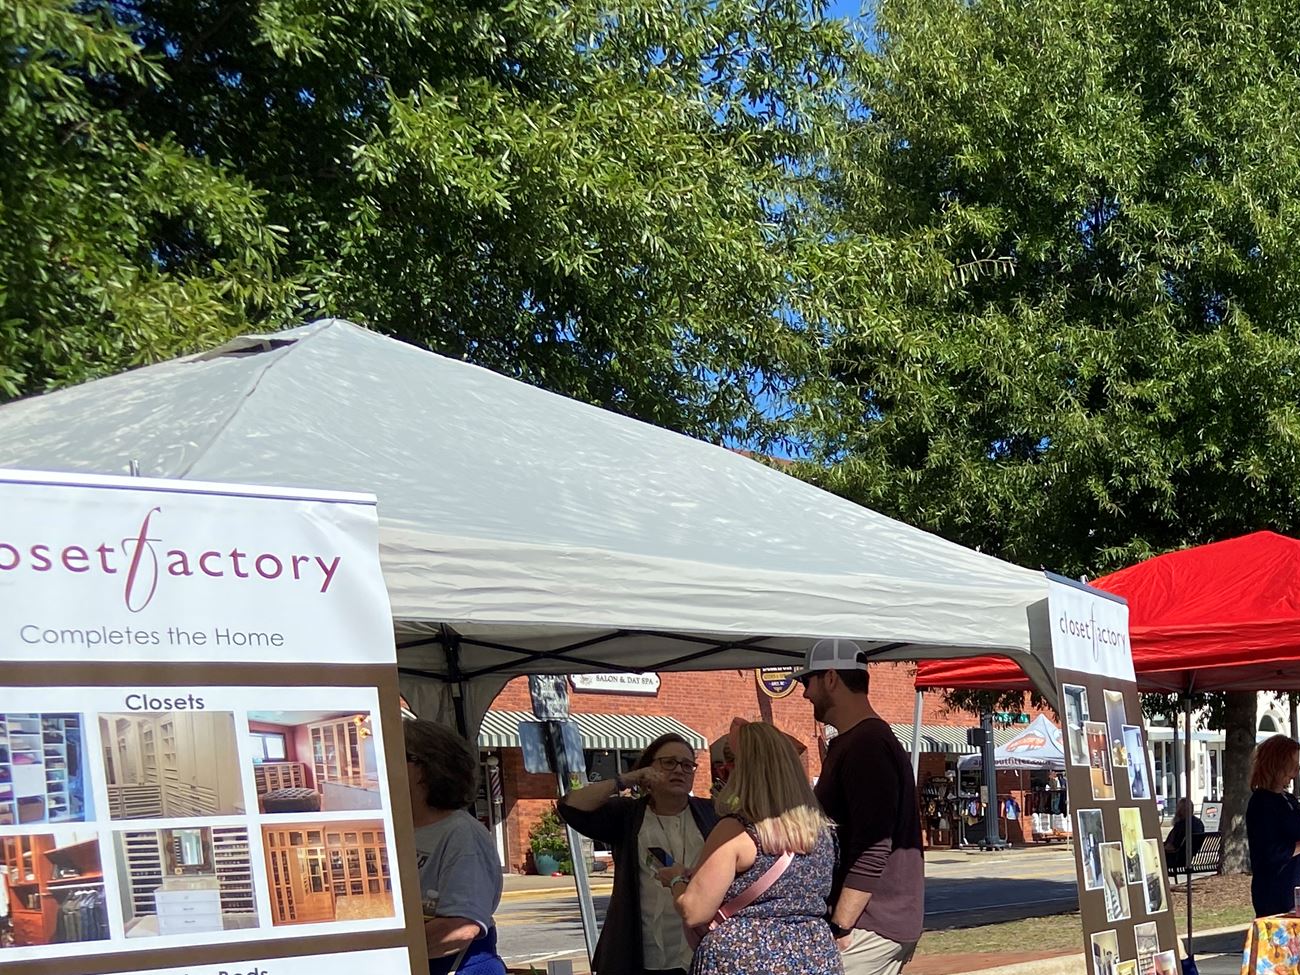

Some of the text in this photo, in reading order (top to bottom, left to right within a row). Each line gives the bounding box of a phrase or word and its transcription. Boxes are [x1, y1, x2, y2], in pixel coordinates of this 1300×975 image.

[20, 624, 285, 649] Completes the Home
[595, 674, 618, 682] SALON
[641, 677, 654, 685] SPA
[125, 693, 205, 710] Closets
